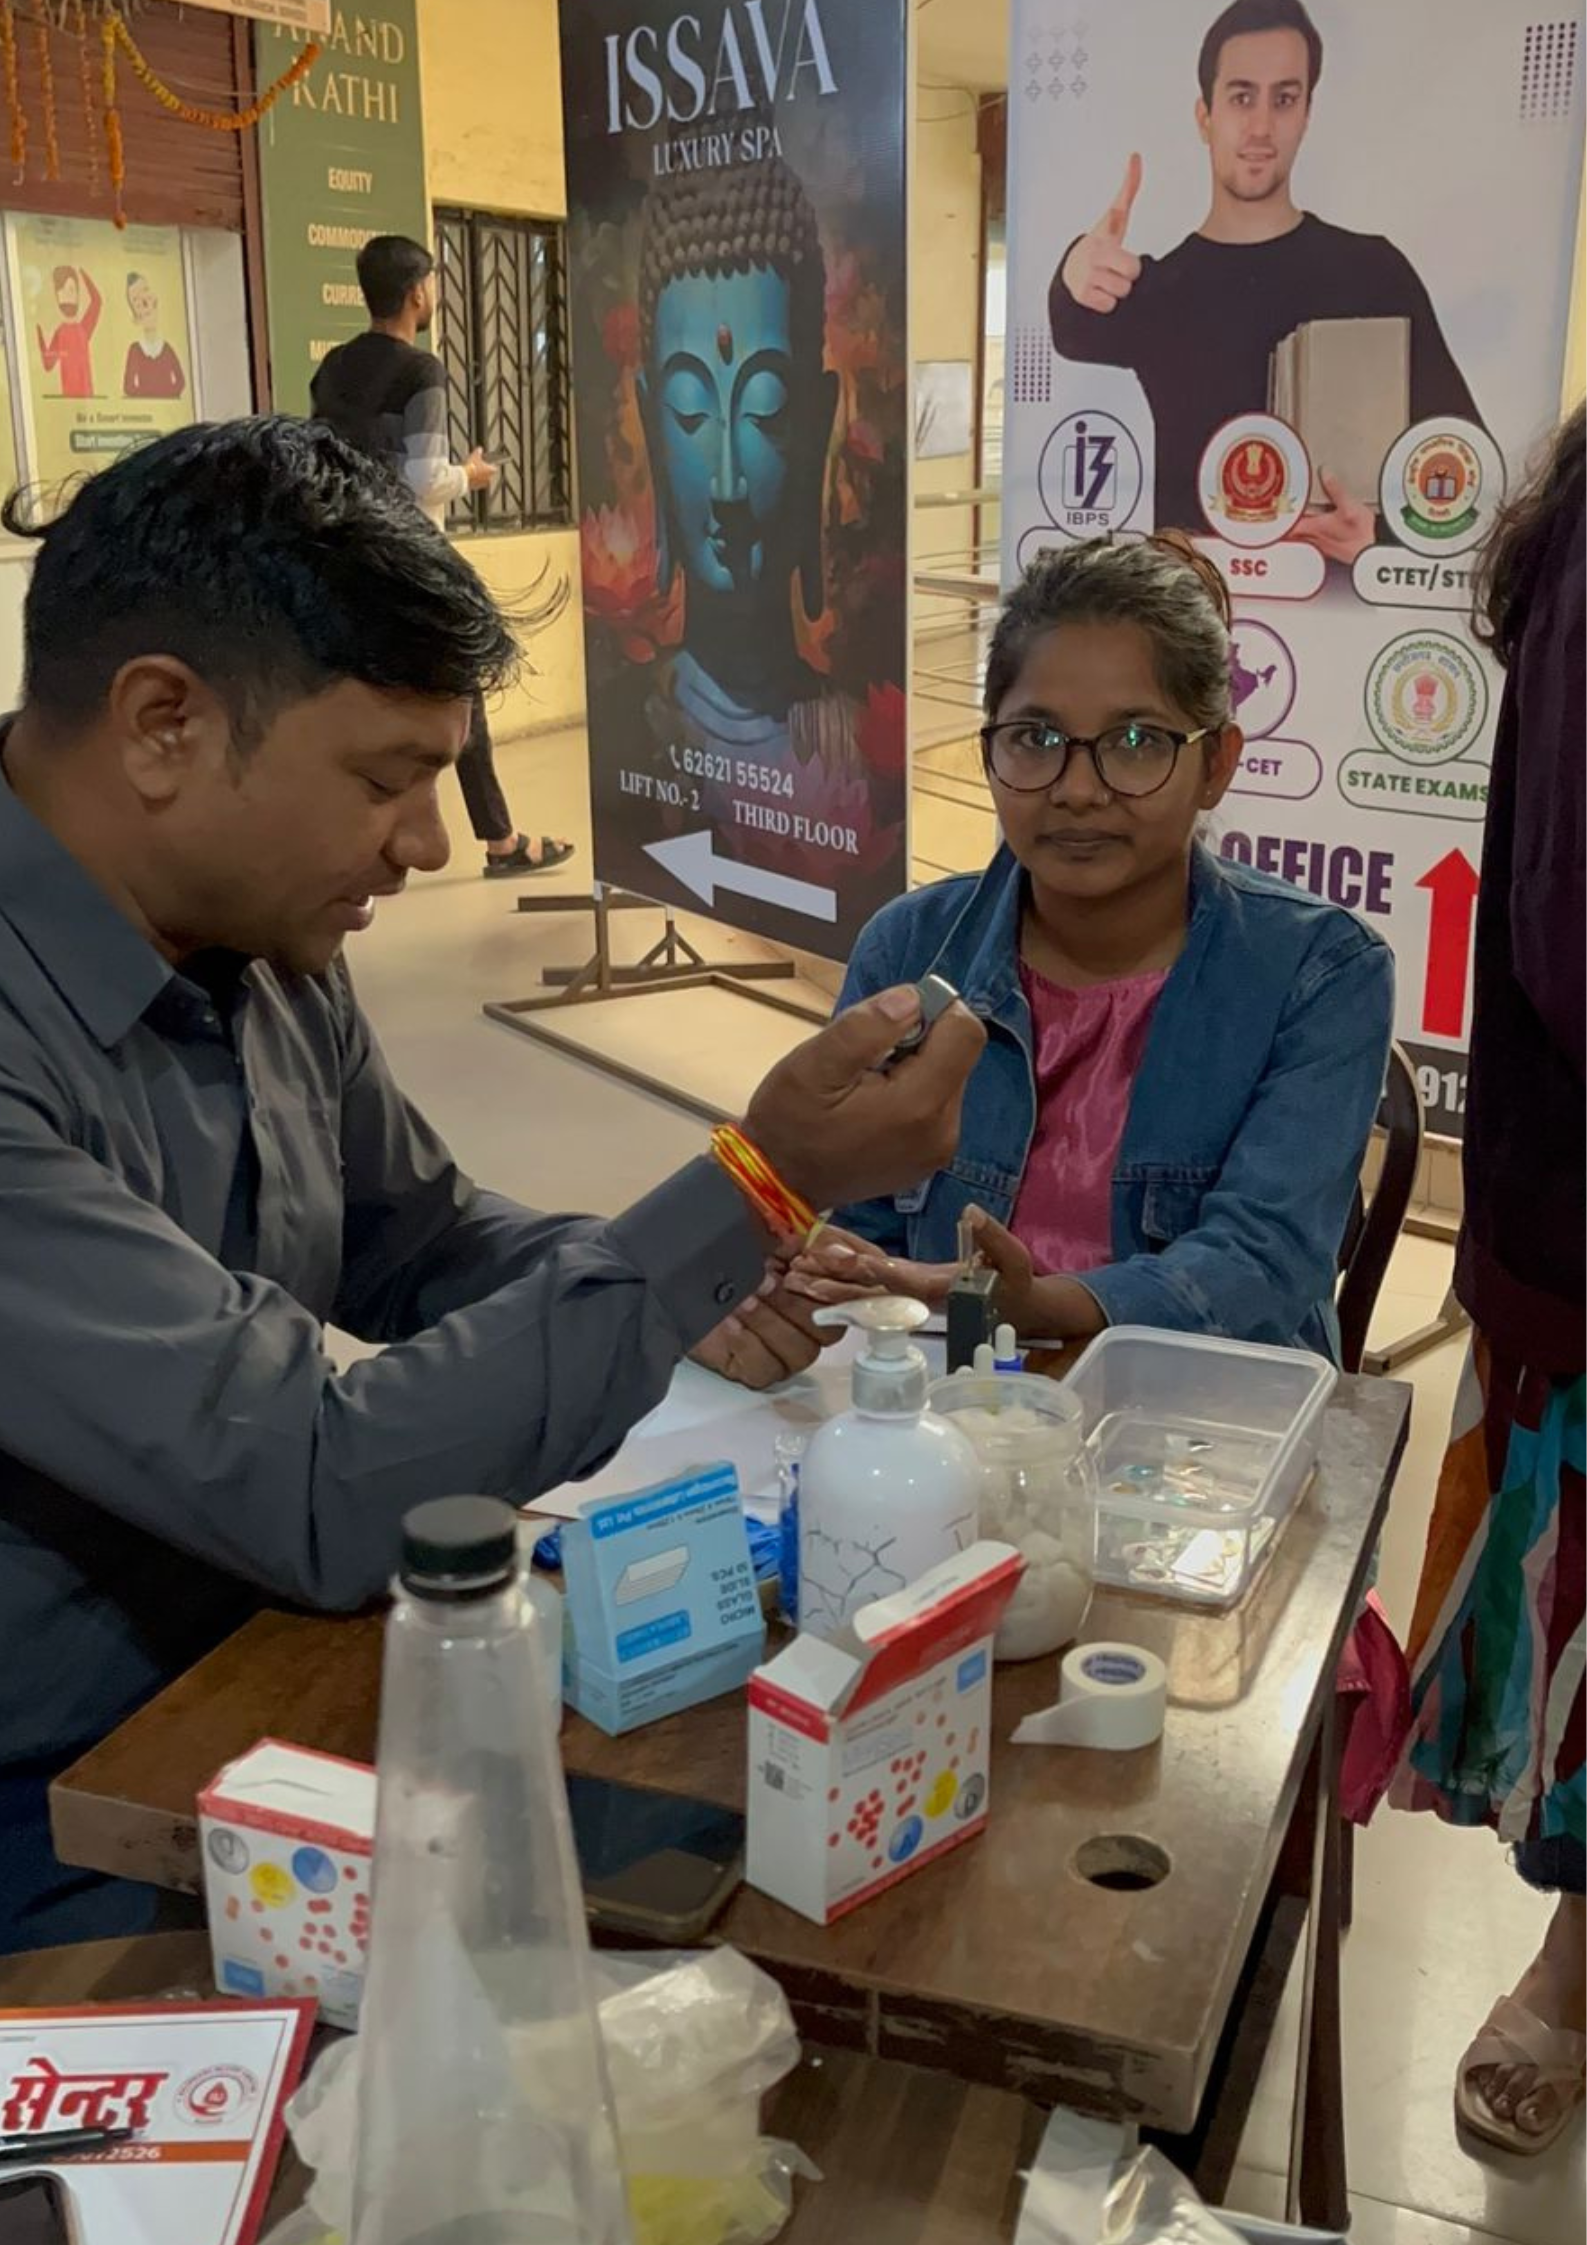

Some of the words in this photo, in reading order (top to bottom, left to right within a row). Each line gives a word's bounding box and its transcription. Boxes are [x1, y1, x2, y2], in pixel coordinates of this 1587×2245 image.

[604, 0, 839, 134] ISSAVA
[653, 131, 735, 176] LUXURY
[740, 126, 782, 162] SPA
[328, 167, 373, 194] EQUITY
[308, 223, 387, 250] COMMOD
[322, 283, 365, 307] CURRE
[1066, 511, 1110, 526] IBPS
[1230, 558, 1269, 576] SSC
[620, 769, 652, 798] LIFT
[683, 749, 732, 784] 62621
[736, 761, 794, 799] 55524
[1347, 770, 1412, 793] STATE
[732, 799, 790, 836] THIRD
[794, 816, 859, 855] FLOOR
